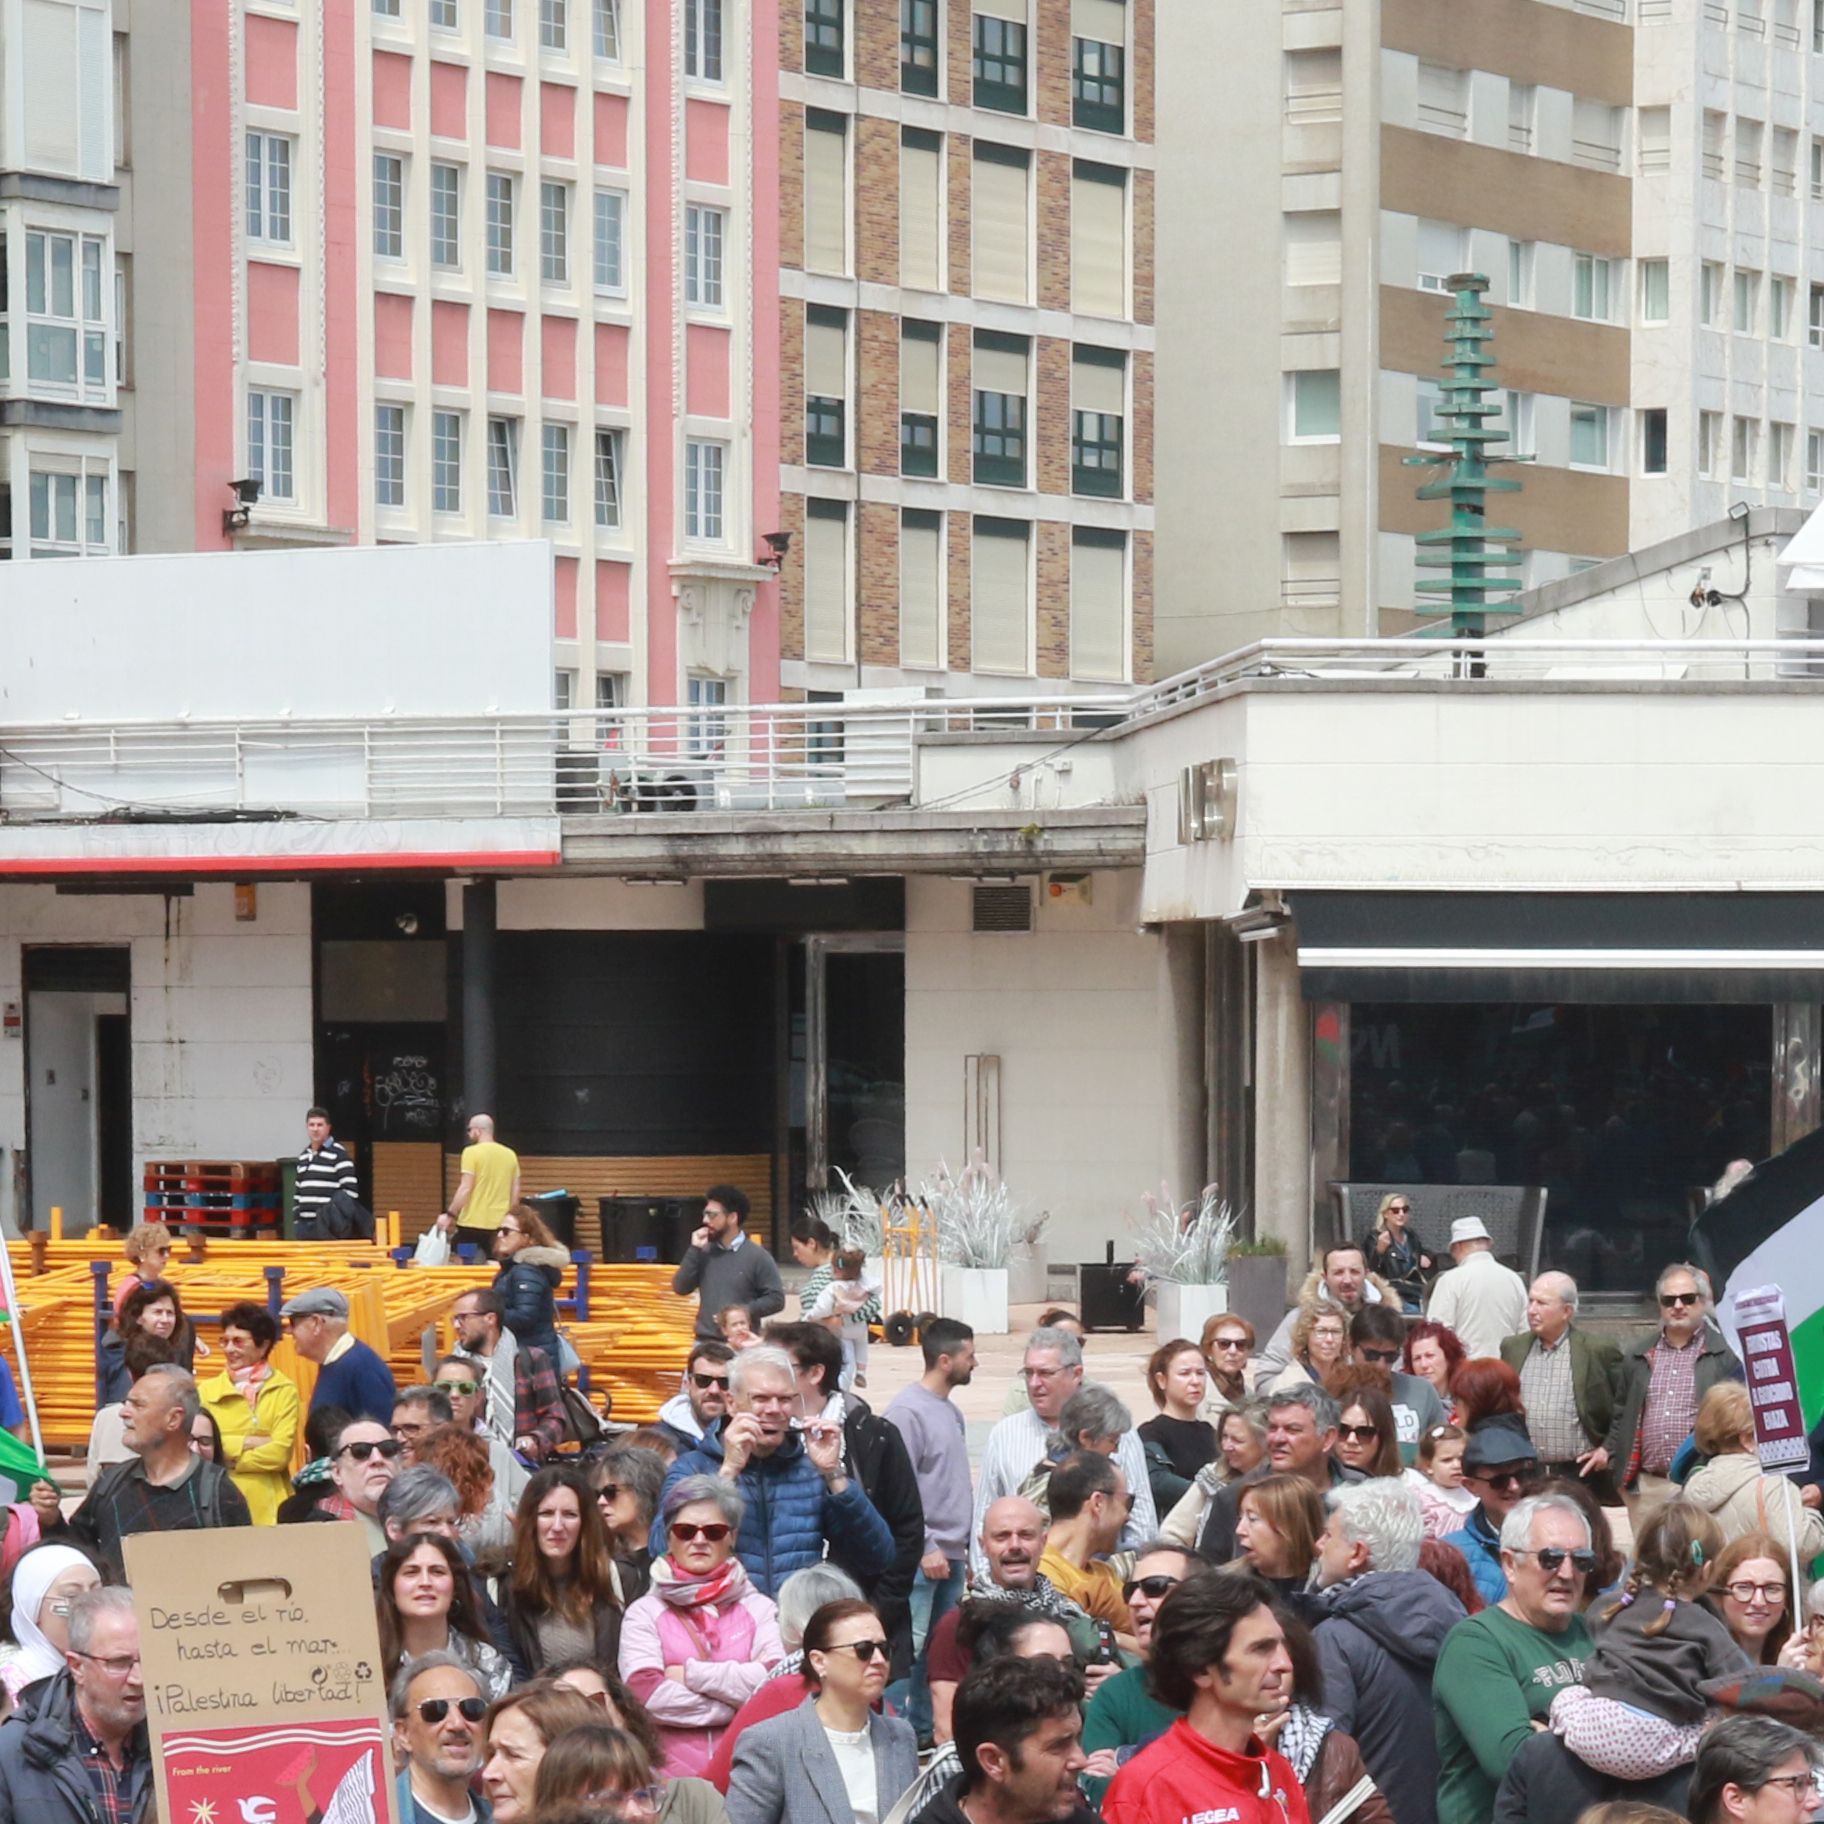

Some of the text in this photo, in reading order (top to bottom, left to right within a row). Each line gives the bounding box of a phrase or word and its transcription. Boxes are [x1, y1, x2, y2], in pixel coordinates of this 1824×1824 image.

[150, 1605, 232, 1631] Desde
[240, 1604, 267, 1624] el
[175, 1636, 239, 1662] hasta
[249, 1635, 277, 1655] el
[271, 1679, 364, 1705] libertad!
[172, 1763, 233, 1777] From the river
